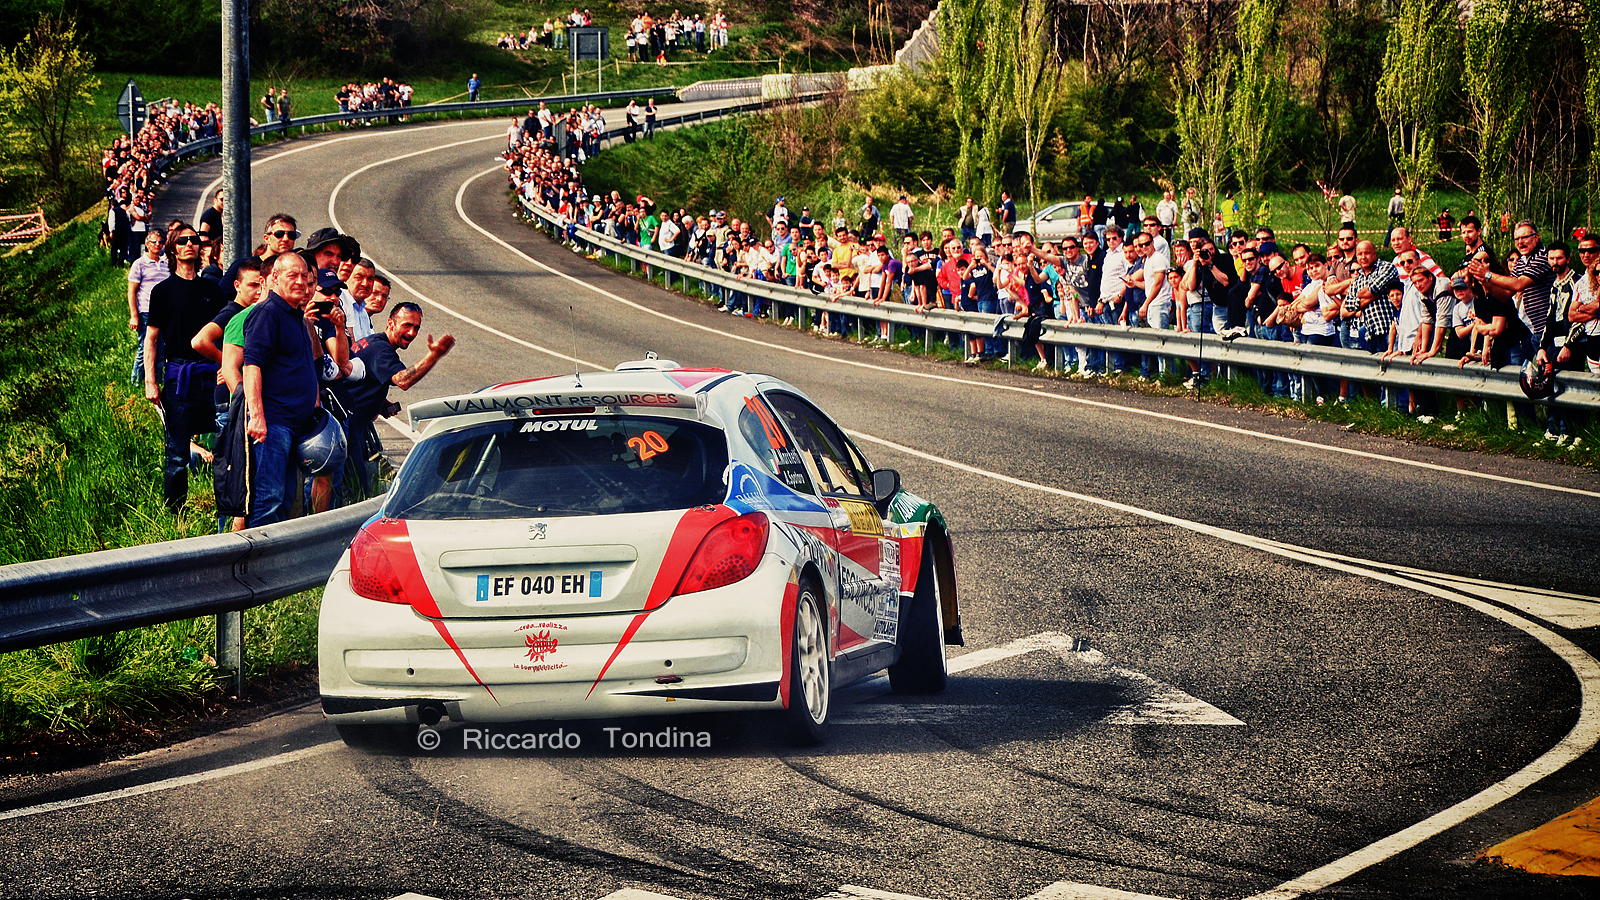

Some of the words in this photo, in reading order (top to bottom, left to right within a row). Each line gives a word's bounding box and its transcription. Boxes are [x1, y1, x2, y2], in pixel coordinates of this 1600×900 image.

[444, 394, 562, 413] VALMONT
[568, 393, 678, 406] RESOURCES
[519, 419, 599, 433] MOTUL
[743, 395, 787, 450] 20
[626, 430, 670, 461] 20
[493, 577, 515, 596] EF
[521, 575, 555, 595] 040
[561, 574, 585, 593] EH
